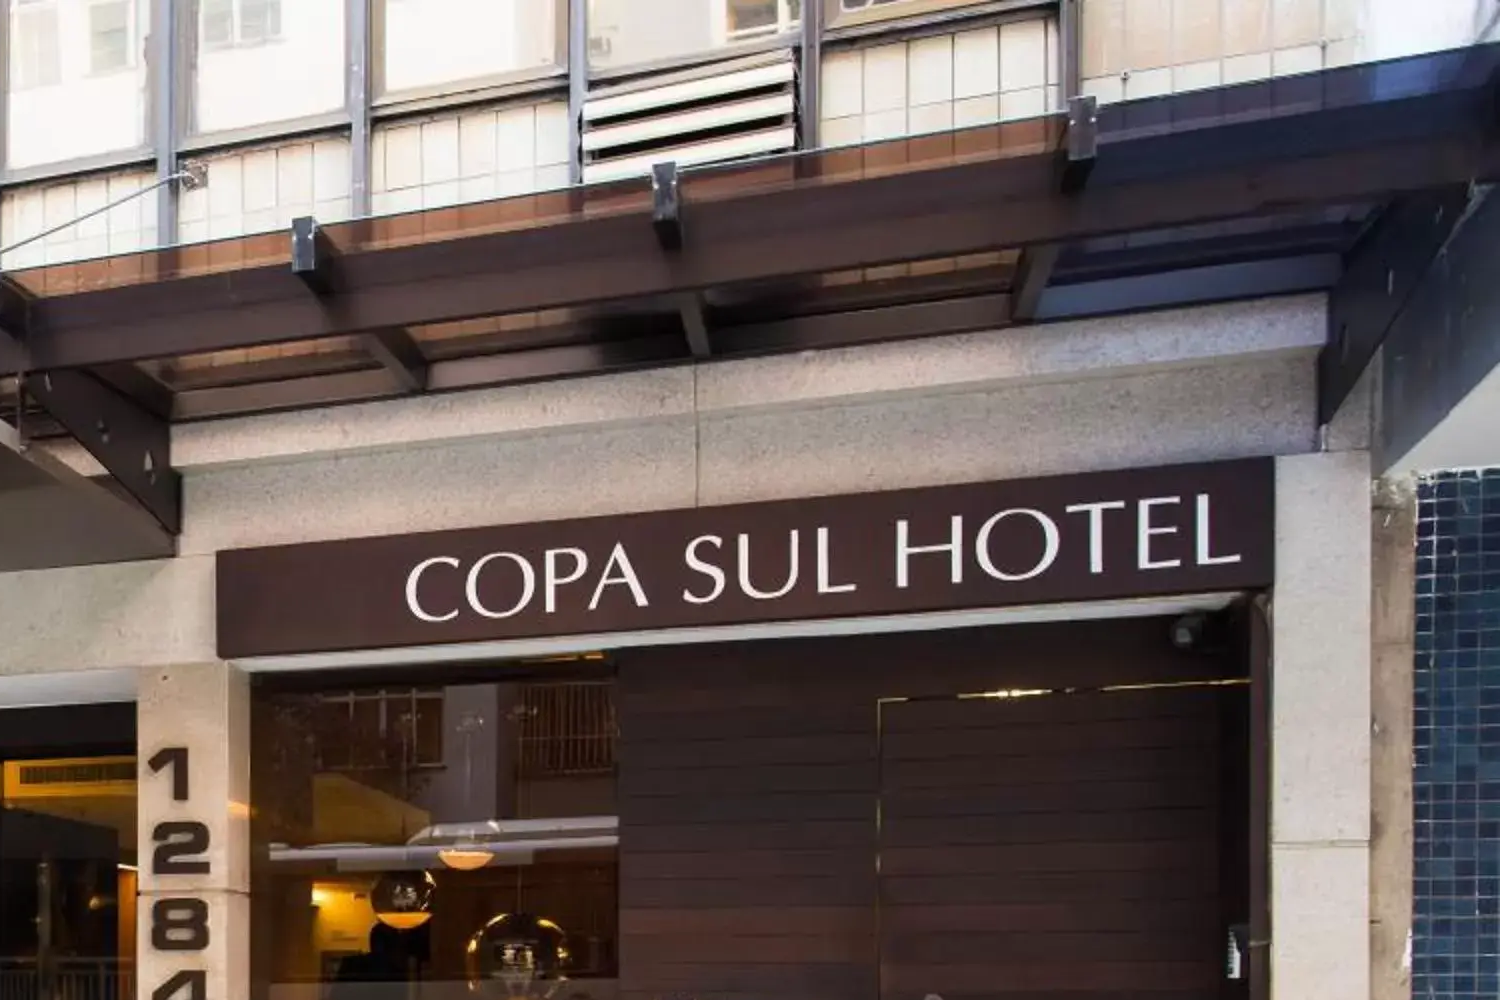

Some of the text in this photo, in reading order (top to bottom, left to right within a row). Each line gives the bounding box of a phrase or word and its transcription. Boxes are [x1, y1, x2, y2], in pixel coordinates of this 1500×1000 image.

[404, 493, 1242, 622] COPA SUL HOTEL
